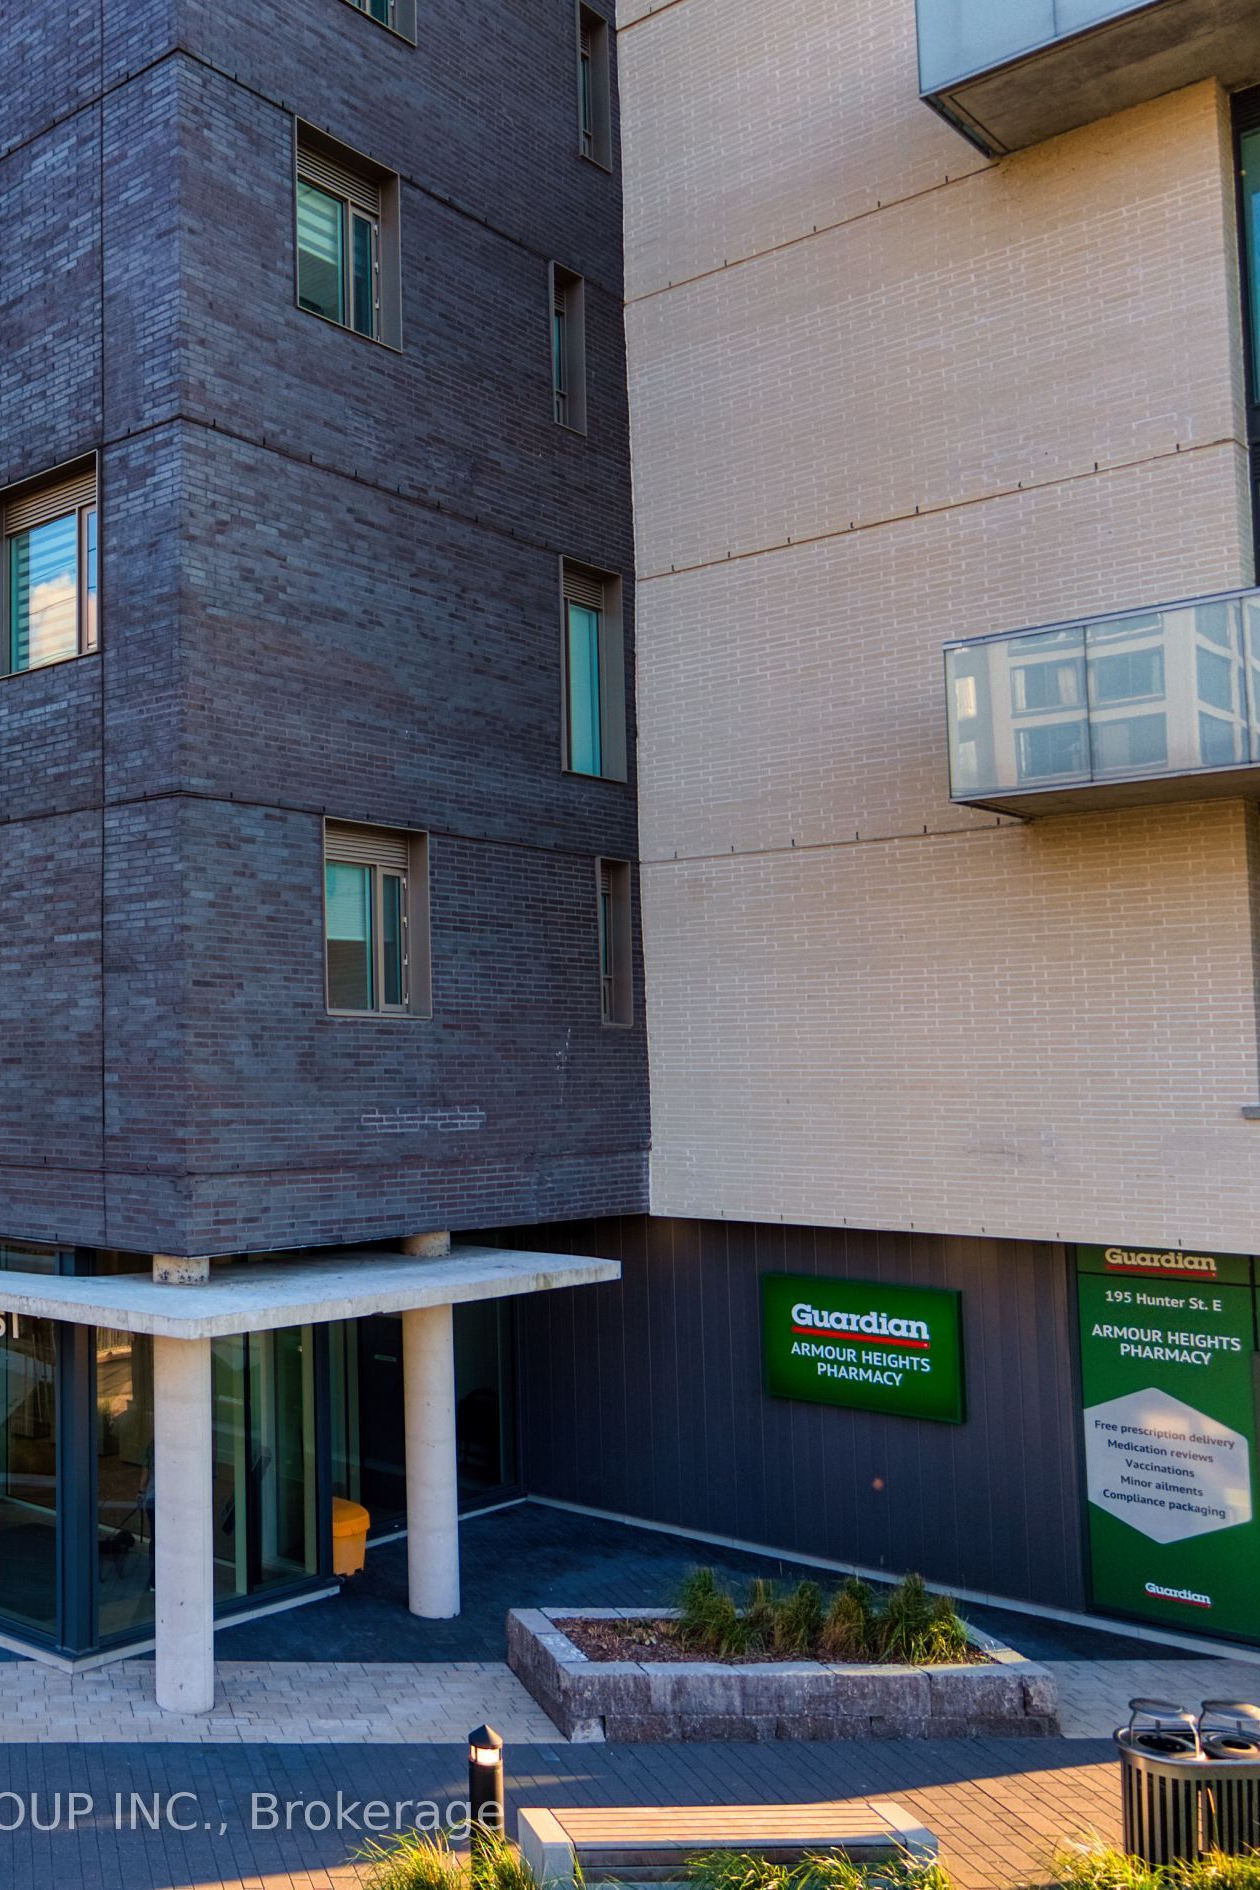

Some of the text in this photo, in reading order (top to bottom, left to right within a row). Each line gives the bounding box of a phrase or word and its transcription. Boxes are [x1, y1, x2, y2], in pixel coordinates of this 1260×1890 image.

[1105, 1248, 1217, 1271] Guardian
[1105, 1290, 1222, 1311] 195 Hunter St. E
[791, 1303, 930, 1340] Guardian
[1092, 1323, 1241, 1351] ARMOUR HEIGHTS
[791, 1341, 931, 1372] ARMOUR HEIGHTS
[1120, 1343, 1212, 1365] PHARMACY
[817, 1362, 903, 1387] PHARMACY
[1094, 1420, 1235, 1450] Free prescription delivery
[1107, 1439, 1214, 1462] Medication reviews
[1125, 1459, 1195, 1478] Vaccinations
[1121, 1475, 1203, 1497] Minor ailments
[1103, 1489, 1226, 1519] Compliance packaging
[1145, 1582, 1211, 1604] Guardian
